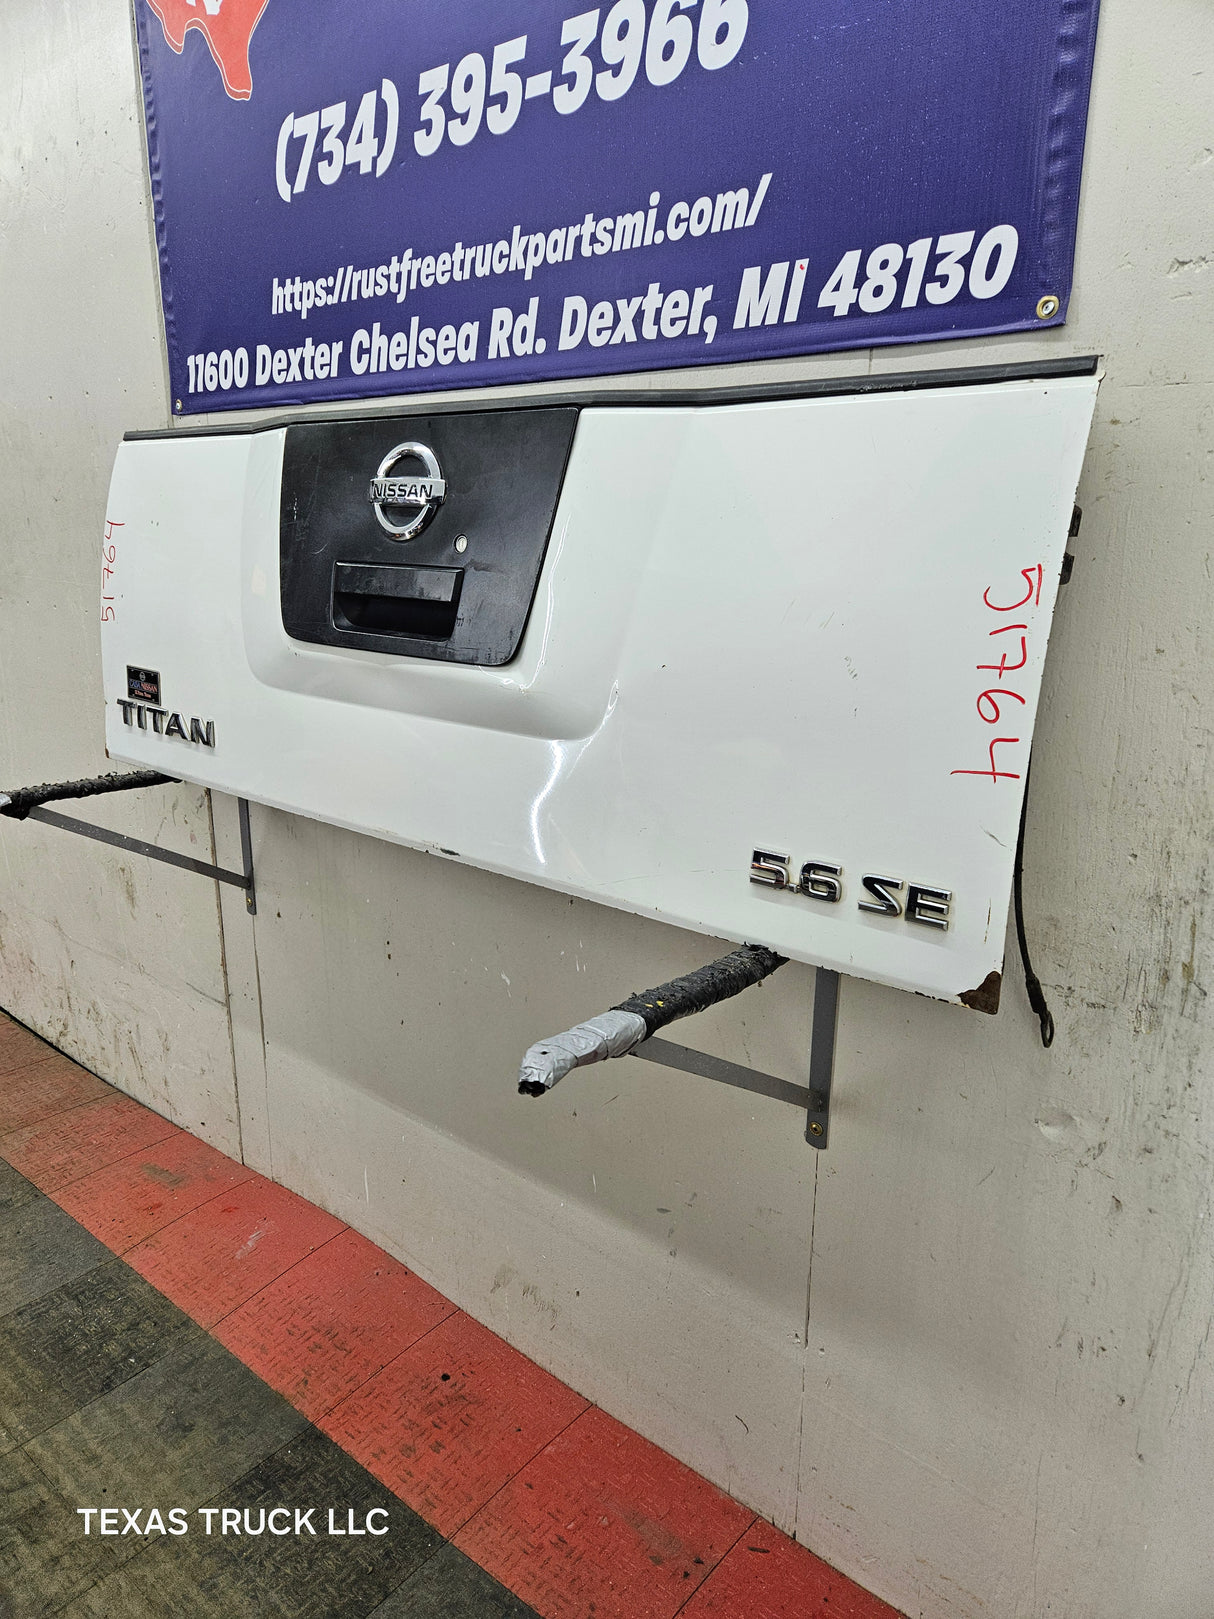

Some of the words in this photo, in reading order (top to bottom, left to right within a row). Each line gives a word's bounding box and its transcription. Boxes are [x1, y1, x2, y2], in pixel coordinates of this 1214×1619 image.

[275, 79, 400, 203] (734)
[414, 0, 749, 157] 395-3966
[271, 173, 774, 319] https://rustfreetruckpartsmi.com/
[186, 346, 249, 394] 11600
[255, 338, 343, 385] Dexter
[349, 316, 480, 376] Chelsea
[487, 296, 547, 361] Rd.
[557, 281, 717, 352] Dexter,
[732, 258, 810, 331] MI
[817, 224, 1019, 318] 48130
[373, 483, 433, 499] NISSAN
[101, 520, 125, 622] 51764
[117, 698, 216, 748] TITAN
[951, 563, 1043, 783] 51764
[750, 847, 842, 903] 5.6
[858, 873, 953, 931] SE
